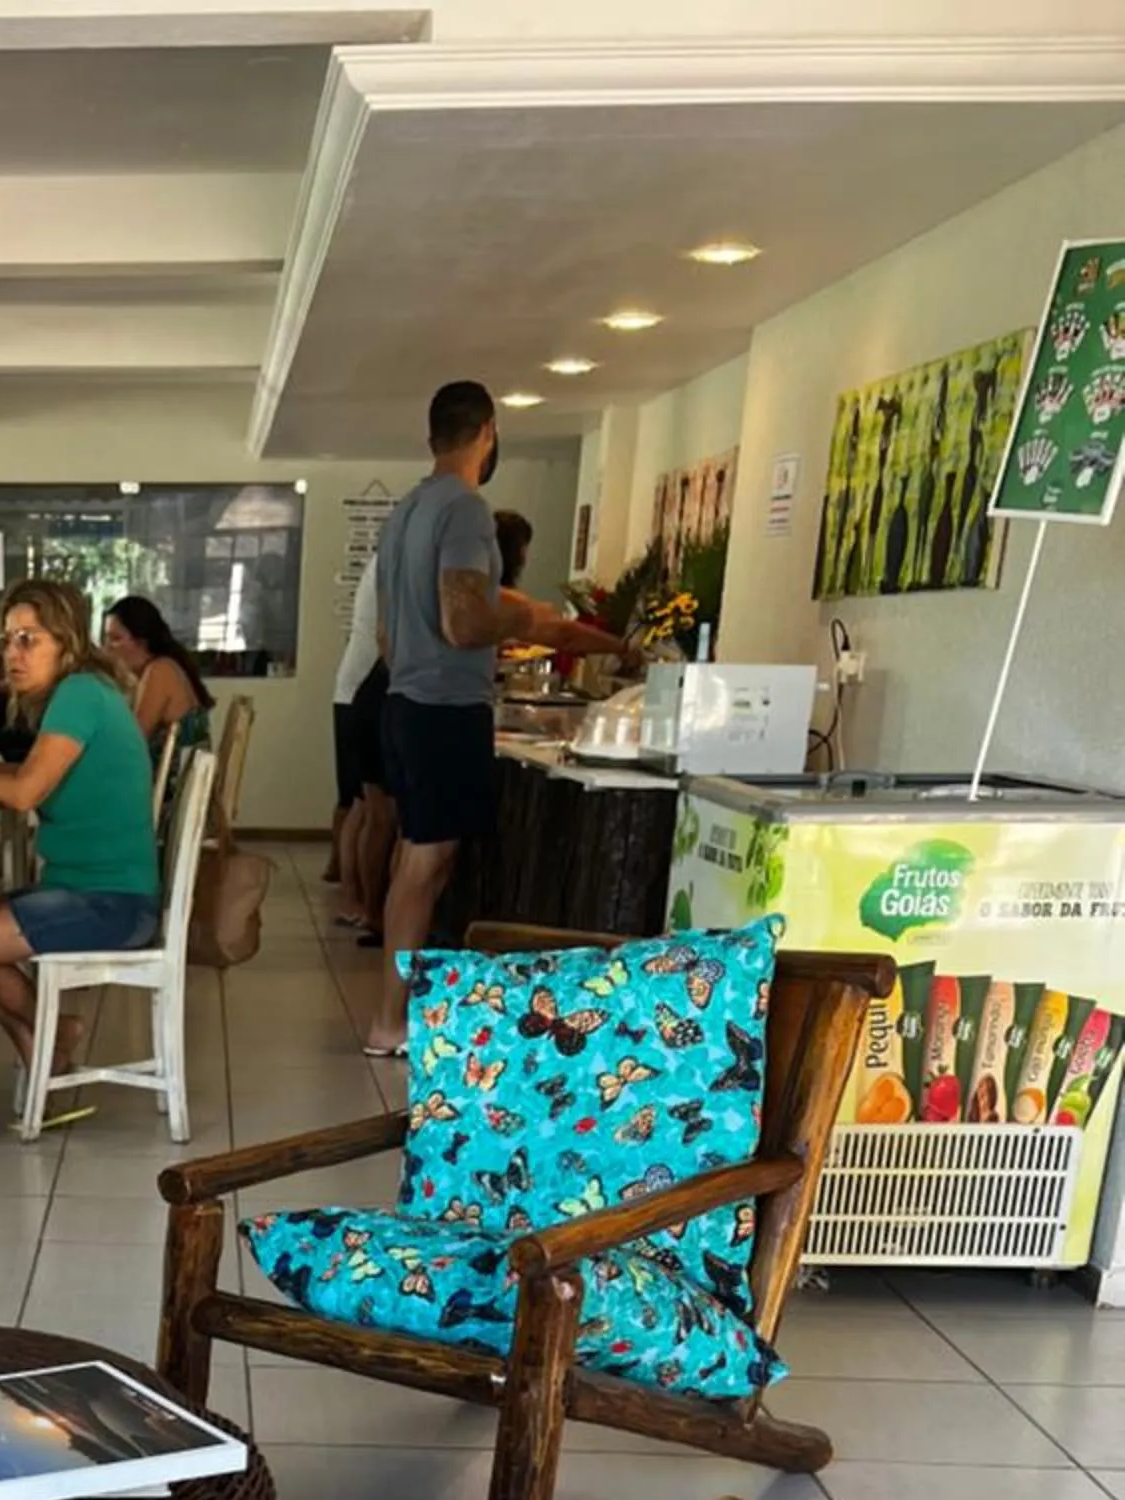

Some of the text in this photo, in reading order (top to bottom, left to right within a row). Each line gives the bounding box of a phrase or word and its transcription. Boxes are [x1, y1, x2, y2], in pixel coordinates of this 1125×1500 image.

[893, 863, 963, 889] Frutos
[880, 888, 952, 917] Goiás
[996, 902, 1053, 918] SABOR
[1060, 902, 1083, 918] DA
[865, 1002, 893, 1070] Pequi
